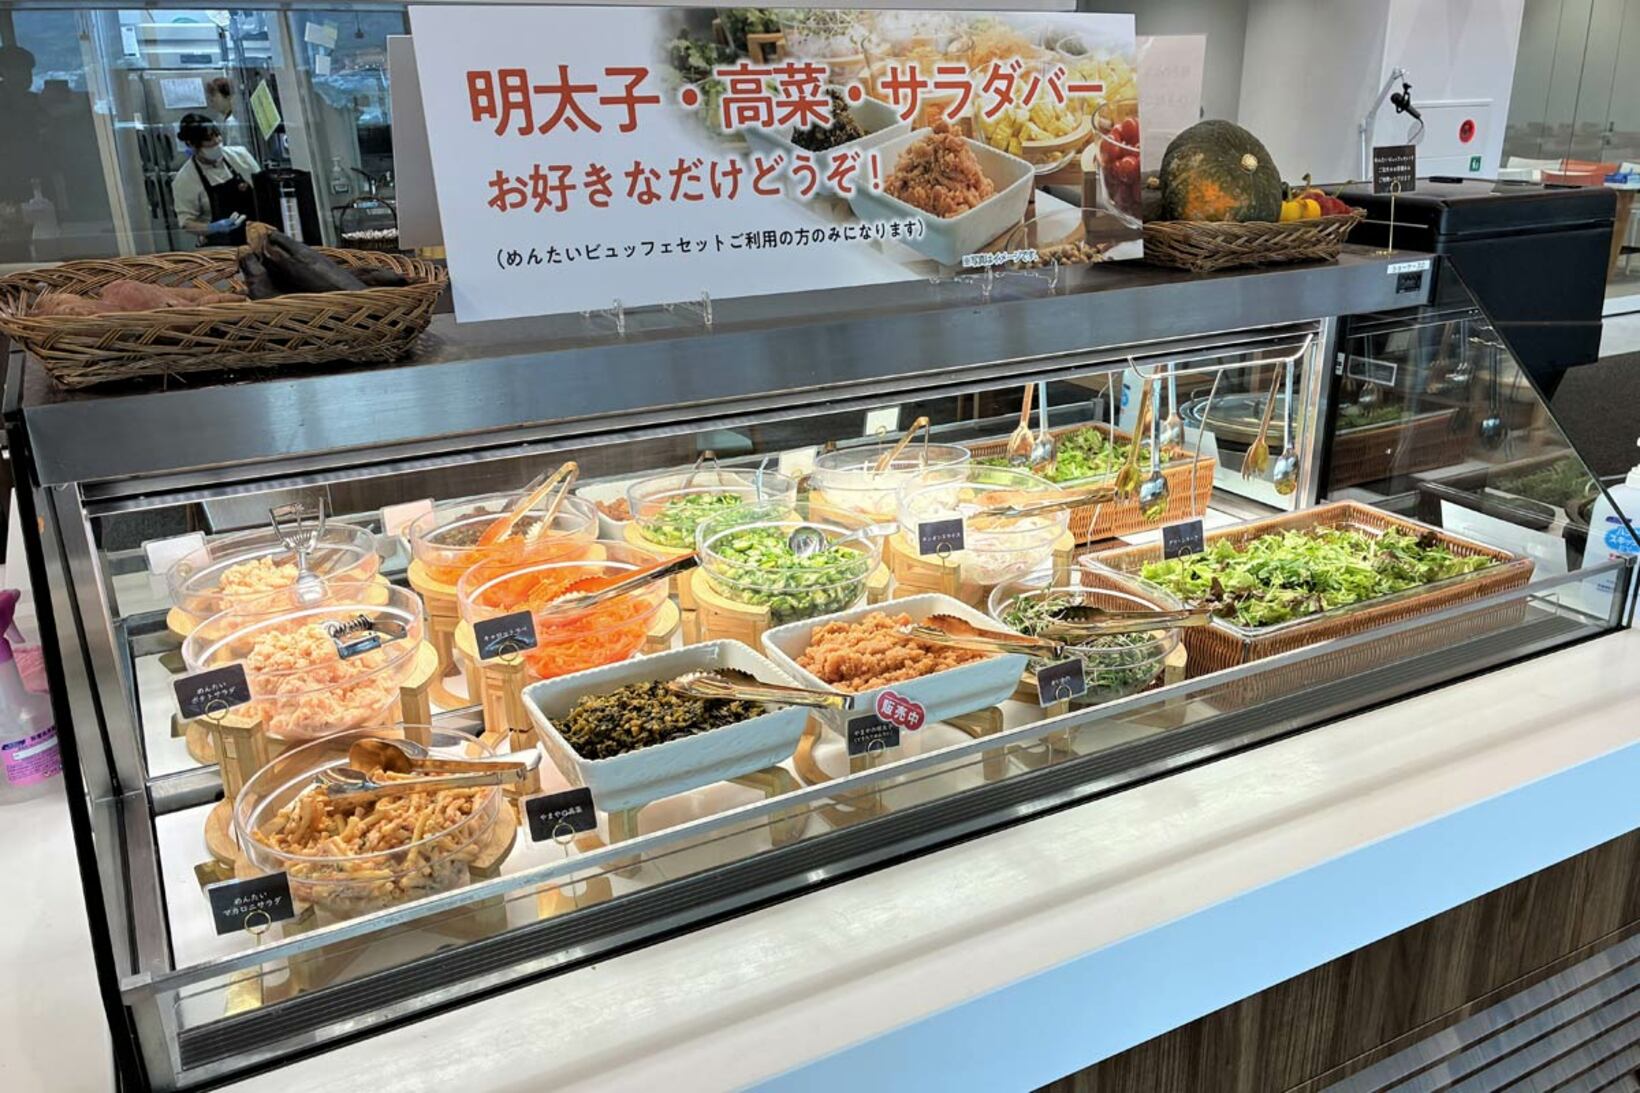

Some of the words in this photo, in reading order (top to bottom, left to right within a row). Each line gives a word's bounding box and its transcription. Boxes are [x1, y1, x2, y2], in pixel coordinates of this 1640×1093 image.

[466, 61, 1105, 137] 明太子・高菜・サラダバー
[487, 153, 884, 215] お好きなだけどうぞ!
[496, 218, 926, 271] (めんたいビュッフェセットご利用の方のみになります)
[881, 698, 919, 726] 販売中
[223, 896, 282, 916] マカロニサラダ
[234, 892, 268, 905] めんたい
